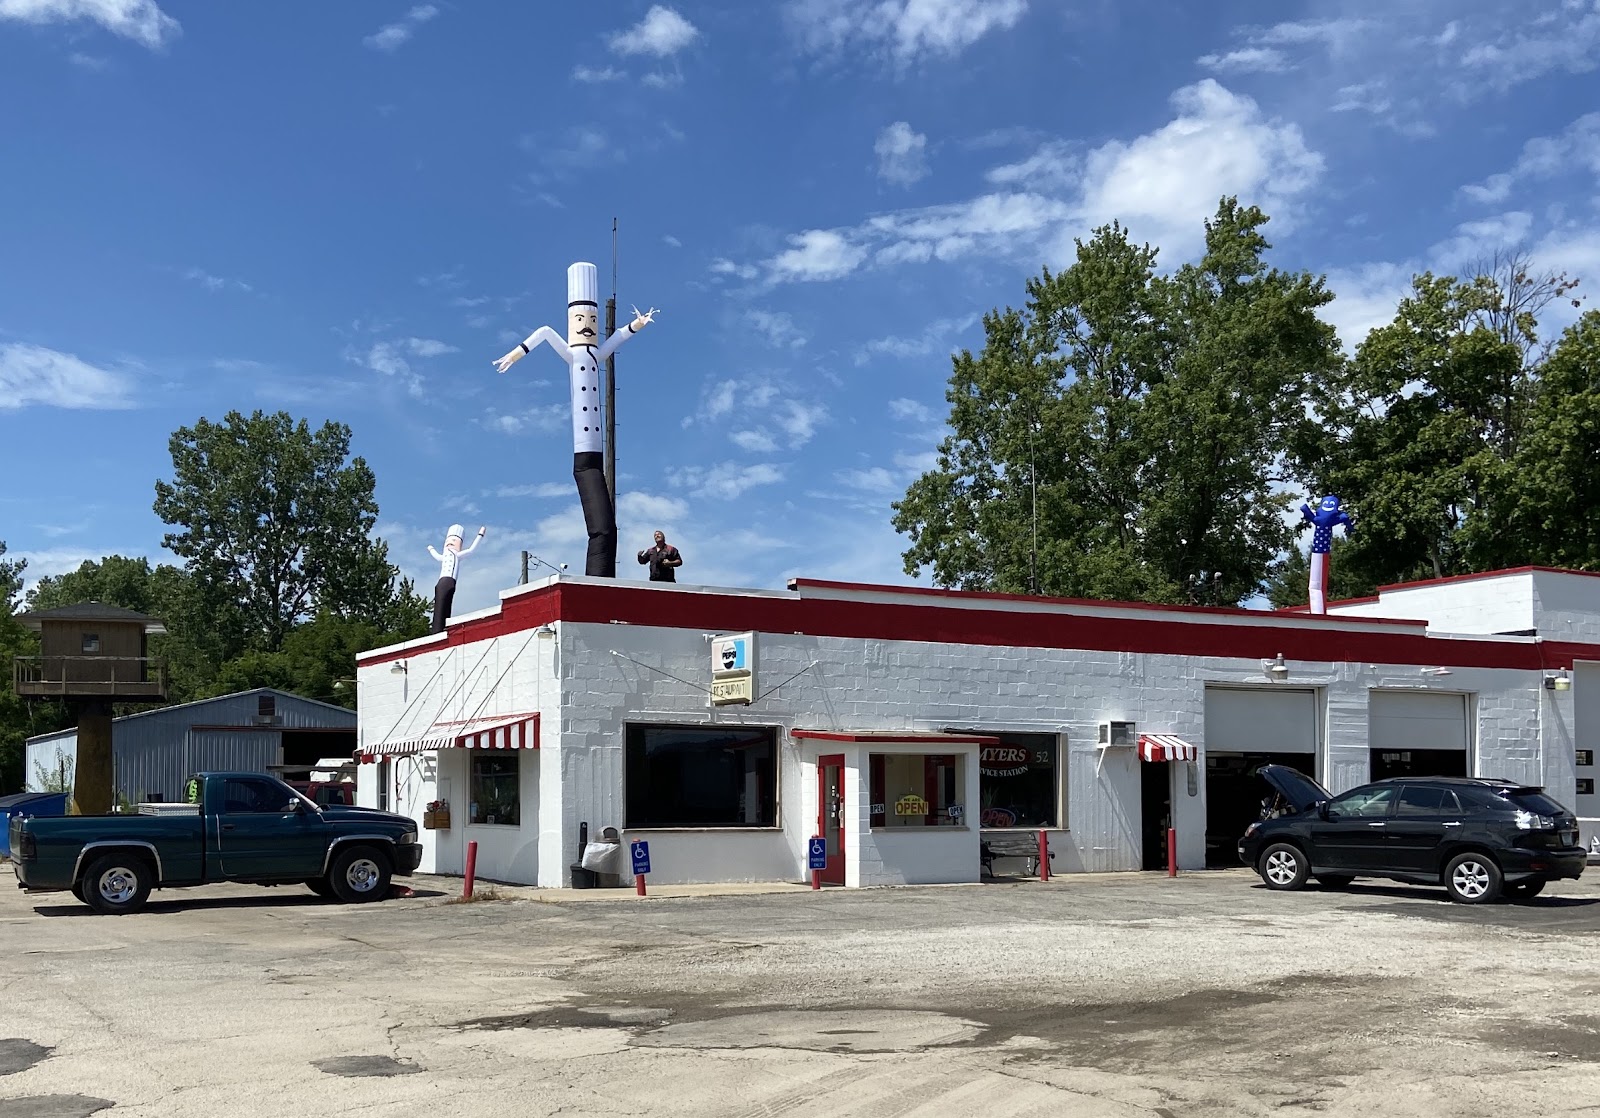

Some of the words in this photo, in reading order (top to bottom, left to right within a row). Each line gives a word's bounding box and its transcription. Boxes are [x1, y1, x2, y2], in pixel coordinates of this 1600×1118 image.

[722, 651, 737, 659] PEPSI
[1035, 751, 1049, 763] 52
[998, 764, 1029, 777] STATION
[895, 802, 928, 814] OPEN!
[949, 806, 963, 815] OPEN
[981, 809, 1013, 827] OPEN
